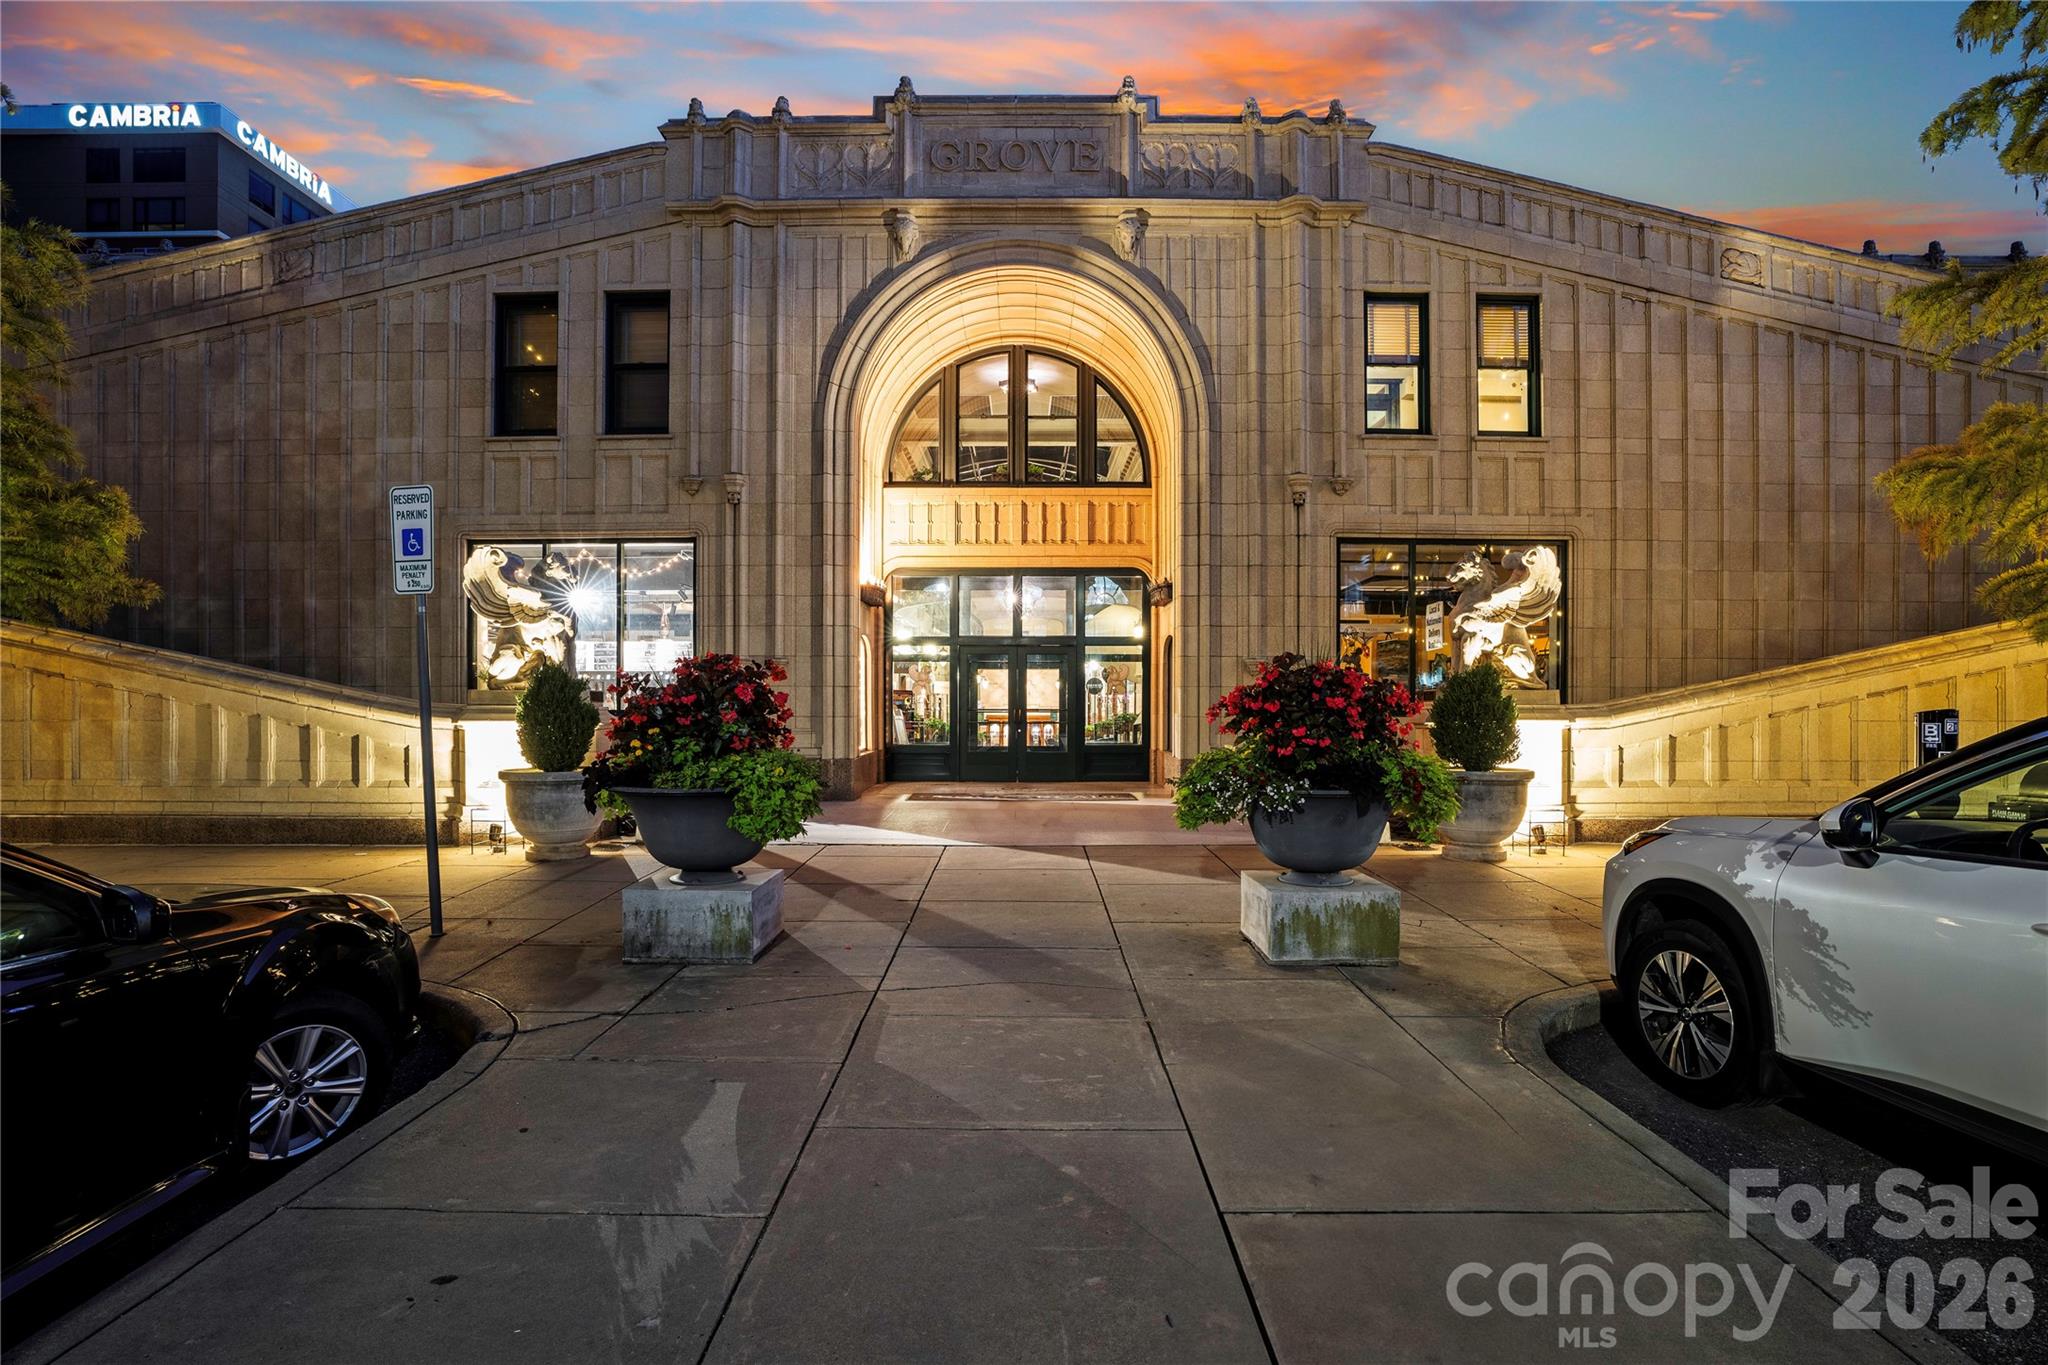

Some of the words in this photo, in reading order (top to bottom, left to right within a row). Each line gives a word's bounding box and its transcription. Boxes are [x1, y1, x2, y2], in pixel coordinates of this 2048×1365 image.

[930, 139, 1100, 172] GROVE
[393, 493, 430, 505] RESERVED
[396, 509, 428, 520] PARKING
[400, 564, 427, 572] MAXIMUM
[401, 571, 425, 579] PENALTY
[1924, 723, 1938, 736] B
